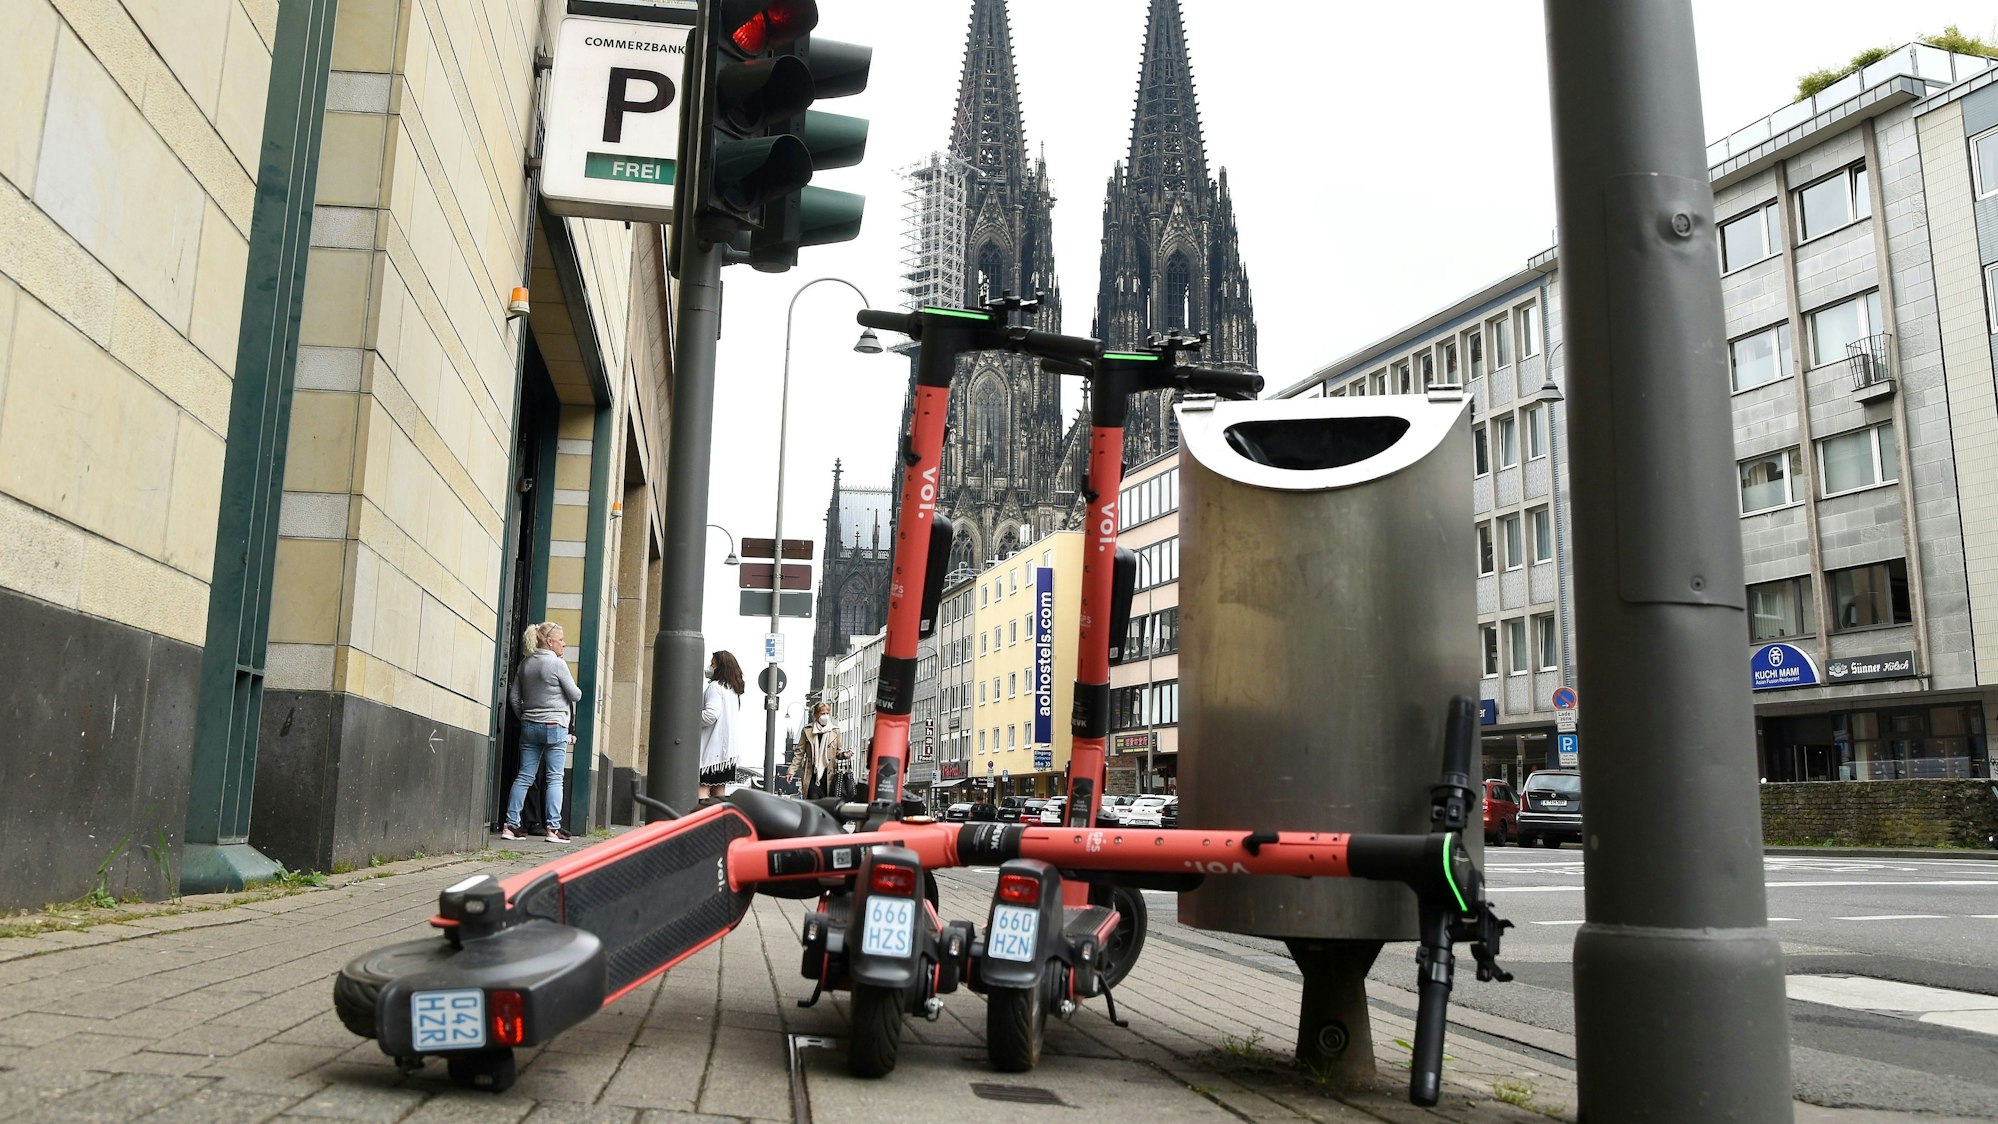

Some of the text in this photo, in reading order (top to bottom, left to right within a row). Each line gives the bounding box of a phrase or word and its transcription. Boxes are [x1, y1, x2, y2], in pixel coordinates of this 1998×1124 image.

[584, 36, 686, 54] COMMERZBANK
[602, 66, 676, 143] P
[612, 161, 661, 180] FREI
[917, 466, 937, 519] voi.
[1099, 502, 1116, 552] voi.
[1036, 591, 1052, 717] aohostels.com
[1755, 667, 1800, 680] KUCHI MAMI
[1851, 660, 1910, 675] Sünner Kölsch
[1563, 737, 1573, 751] P
[717, 856, 726, 892] voi.
[872, 902, 907, 925] 666
[999, 911, 1032, 933] 660
[868, 928, 906, 951] HZS
[993, 935, 1030, 956] HZN
[419, 997, 446, 1043] HZR
